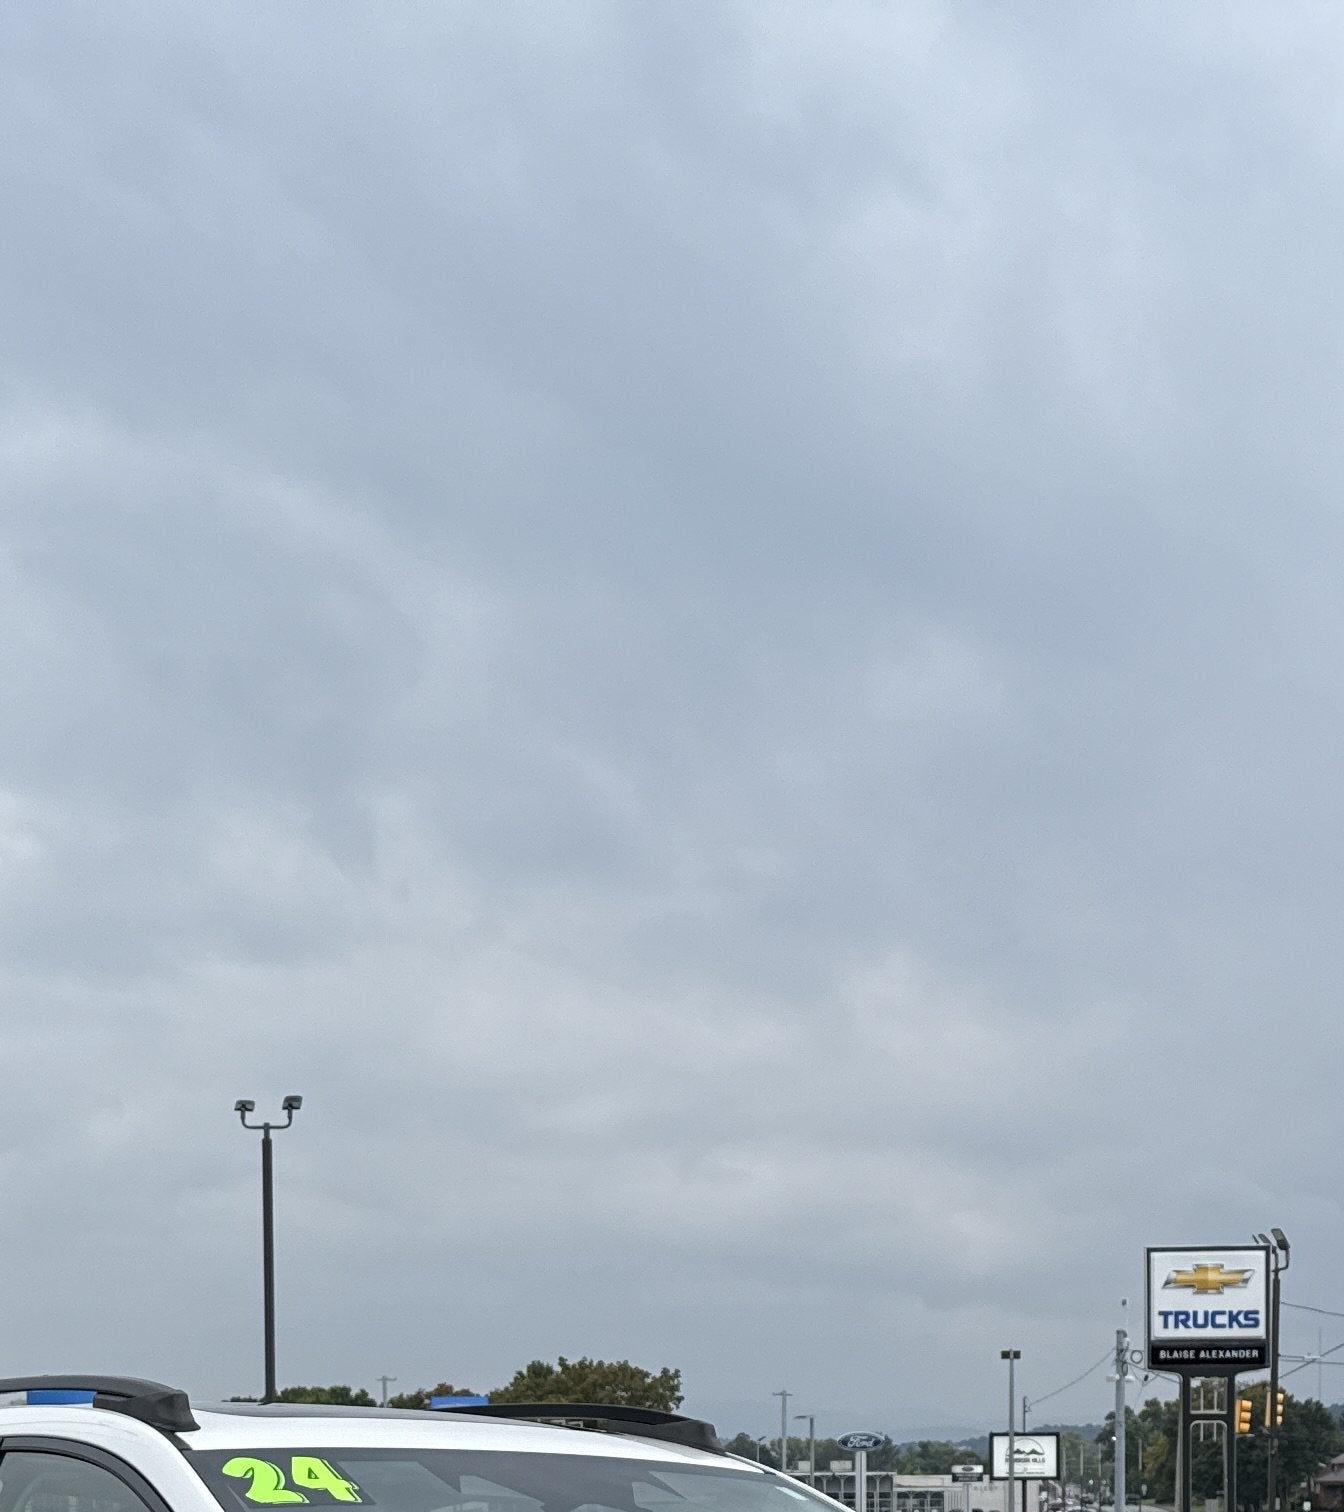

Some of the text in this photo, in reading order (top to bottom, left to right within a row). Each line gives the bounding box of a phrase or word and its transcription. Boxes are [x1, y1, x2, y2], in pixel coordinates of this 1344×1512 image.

[1157, 1309, 1260, 1329] TRUCKS
[1159, 1349, 1259, 1360] BLAISE ALEXANDER
[221, 1456, 363, 1504] 24
